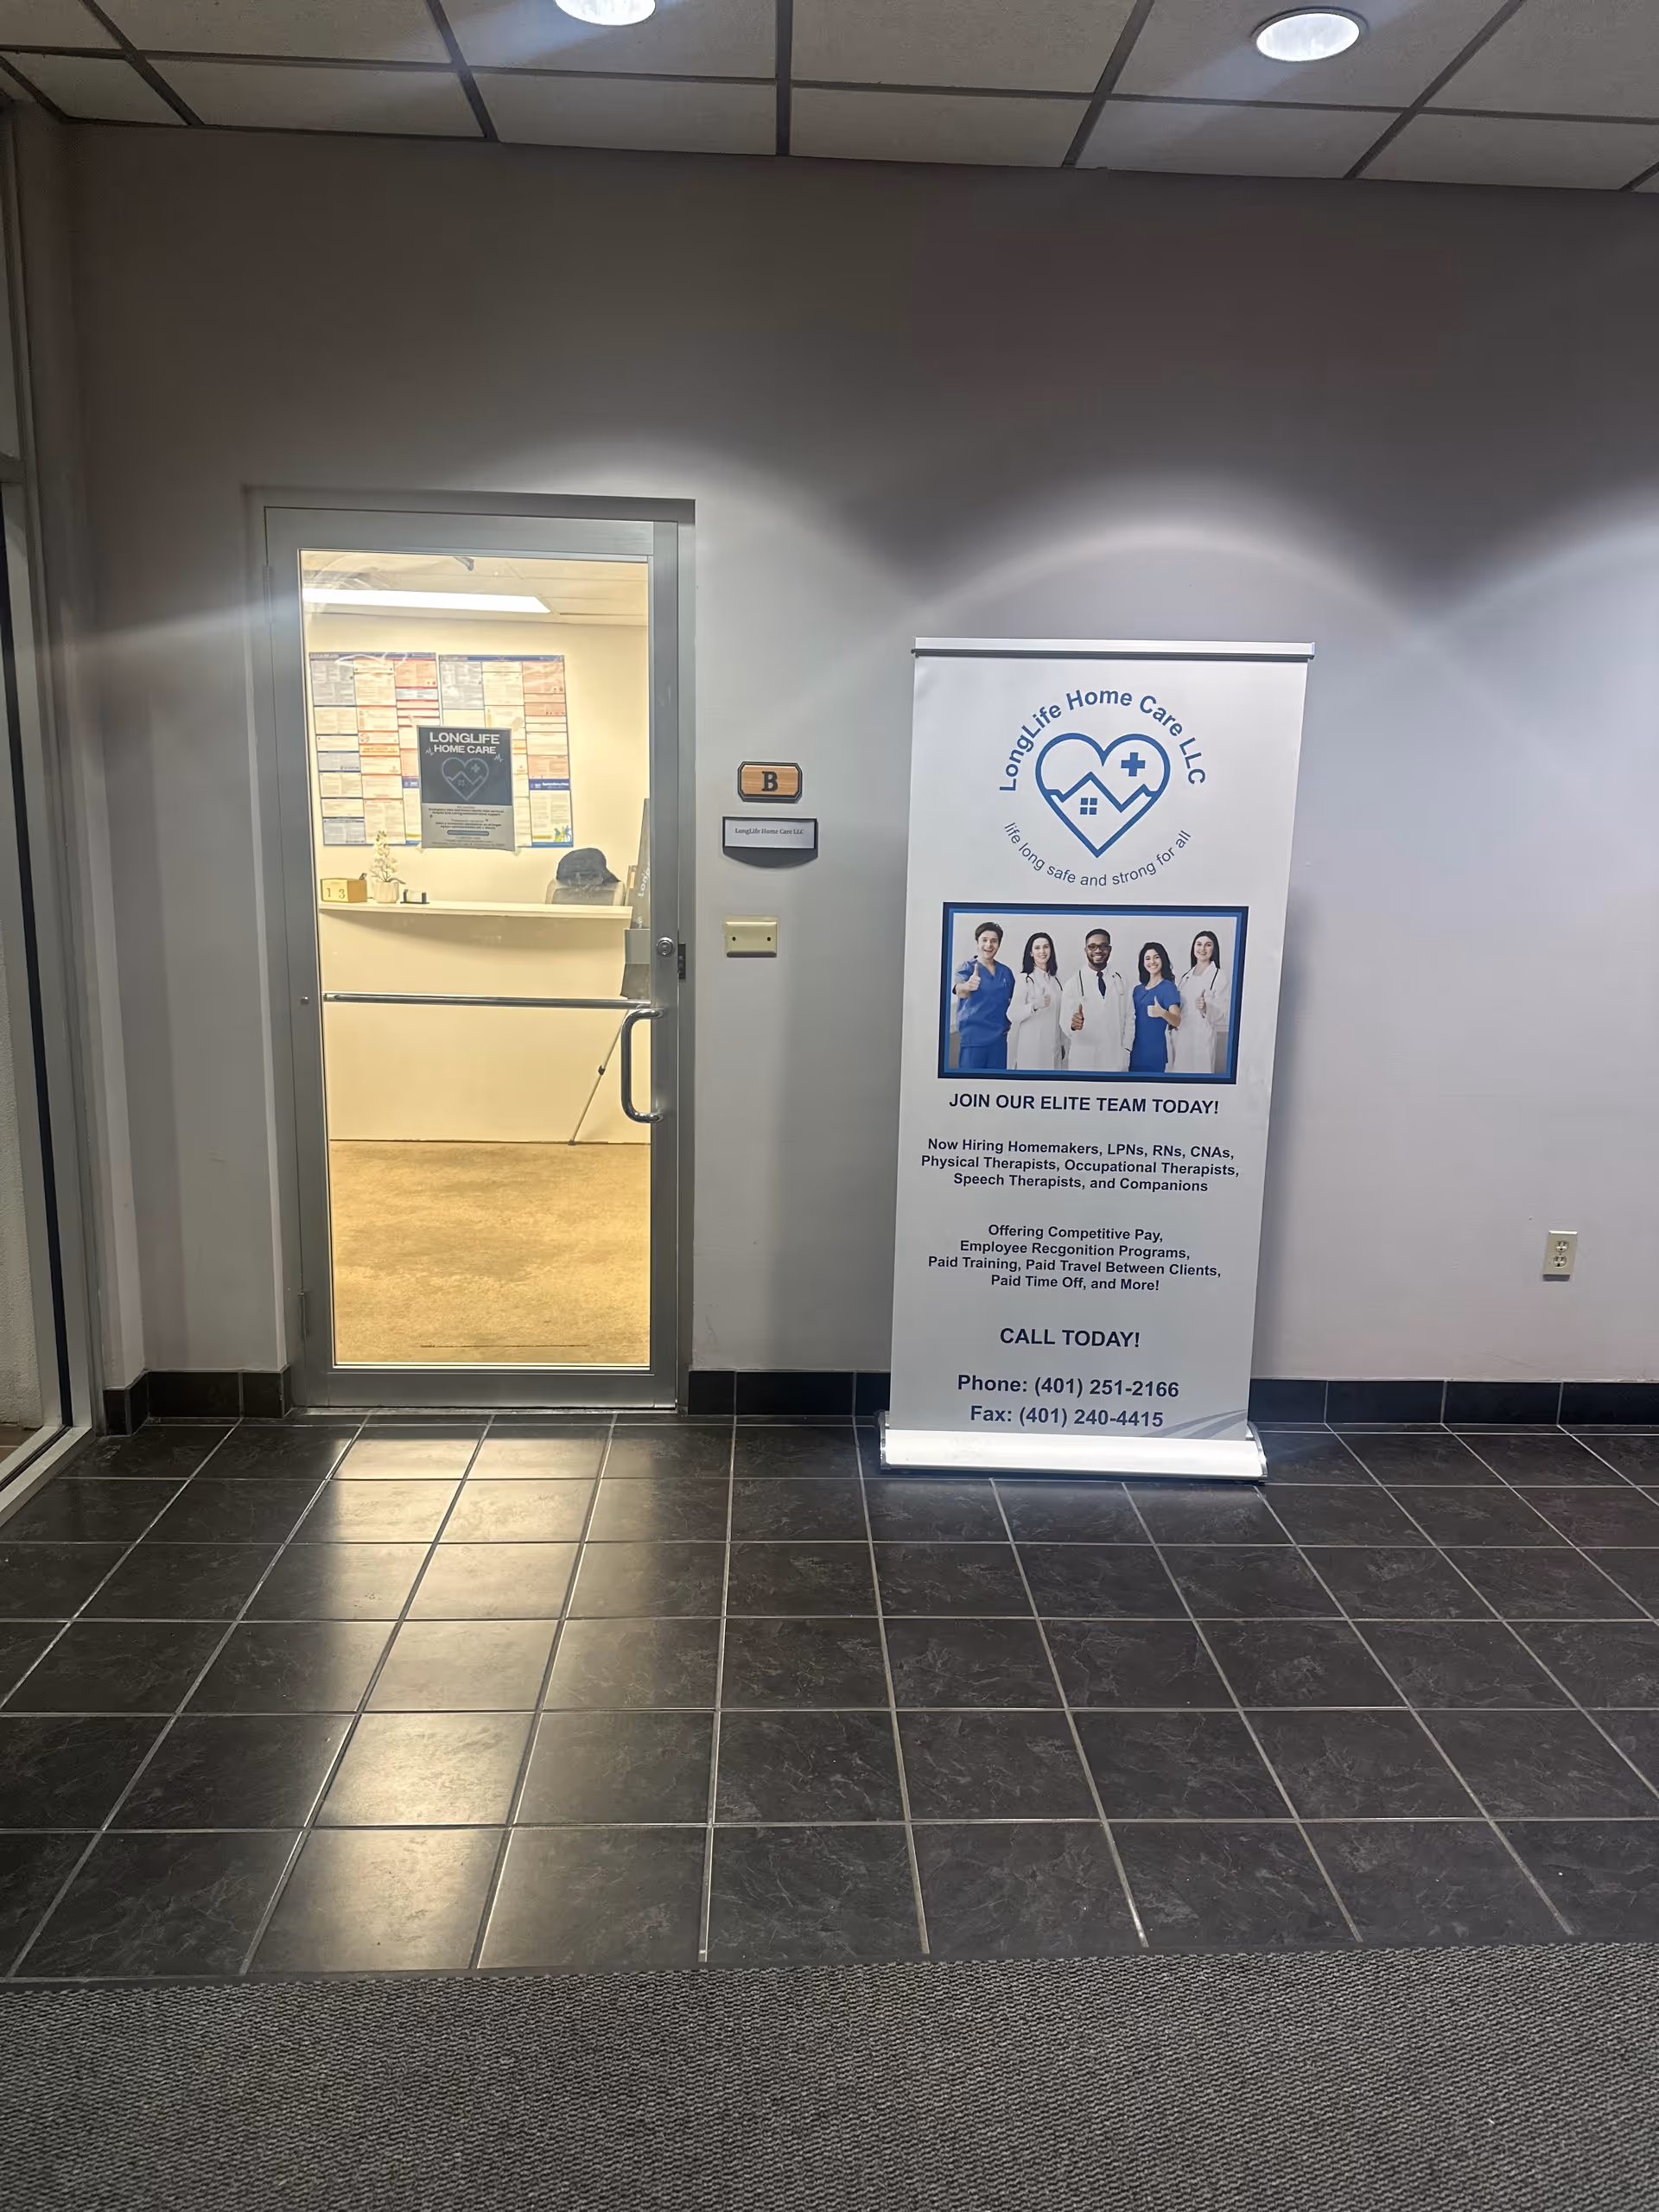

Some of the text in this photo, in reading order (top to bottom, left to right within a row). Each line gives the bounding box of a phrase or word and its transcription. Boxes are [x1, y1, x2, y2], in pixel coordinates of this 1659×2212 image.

[429, 732, 500, 744] LONGLIFE
[1000, 690, 1206, 791] LongLife Home Care LLC
[434, 744, 497, 754] HOME CARE
[761, 771, 779, 791] B
[1004, 823, 1192, 886] life long safe and strong for all
[339, 888, 346, 899] 3
[950, 1094, 1218, 1114] JOIN OUR ELITE TEAM TODAY!
[929, 1139, 1233, 1160] Now Hiring Homemakers, LPNs, RNs, CNAs,
[922, 1155, 1238, 1177] Physical Therapists, Occupational Therapists,
[954, 1173, 1207, 1192] Speech Therapists, and Companions
[988, 1224, 1162, 1243] Offering Competitive Pay,
[961, 1241, 1189, 1260] Employee Recgonition Programs,
[929, 1256, 1220, 1278] Paid Training, Paid Travel Between Clients,
[992, 1274, 1159, 1290] Paid Time Off, and More!
[1001, 1328, 1139, 1347] CALL TODAY!
[958, 1375, 1179, 1398] Phone: (401) 251-2166
[971, 1406, 1162, 1427] Fax: (401) 240-4415
